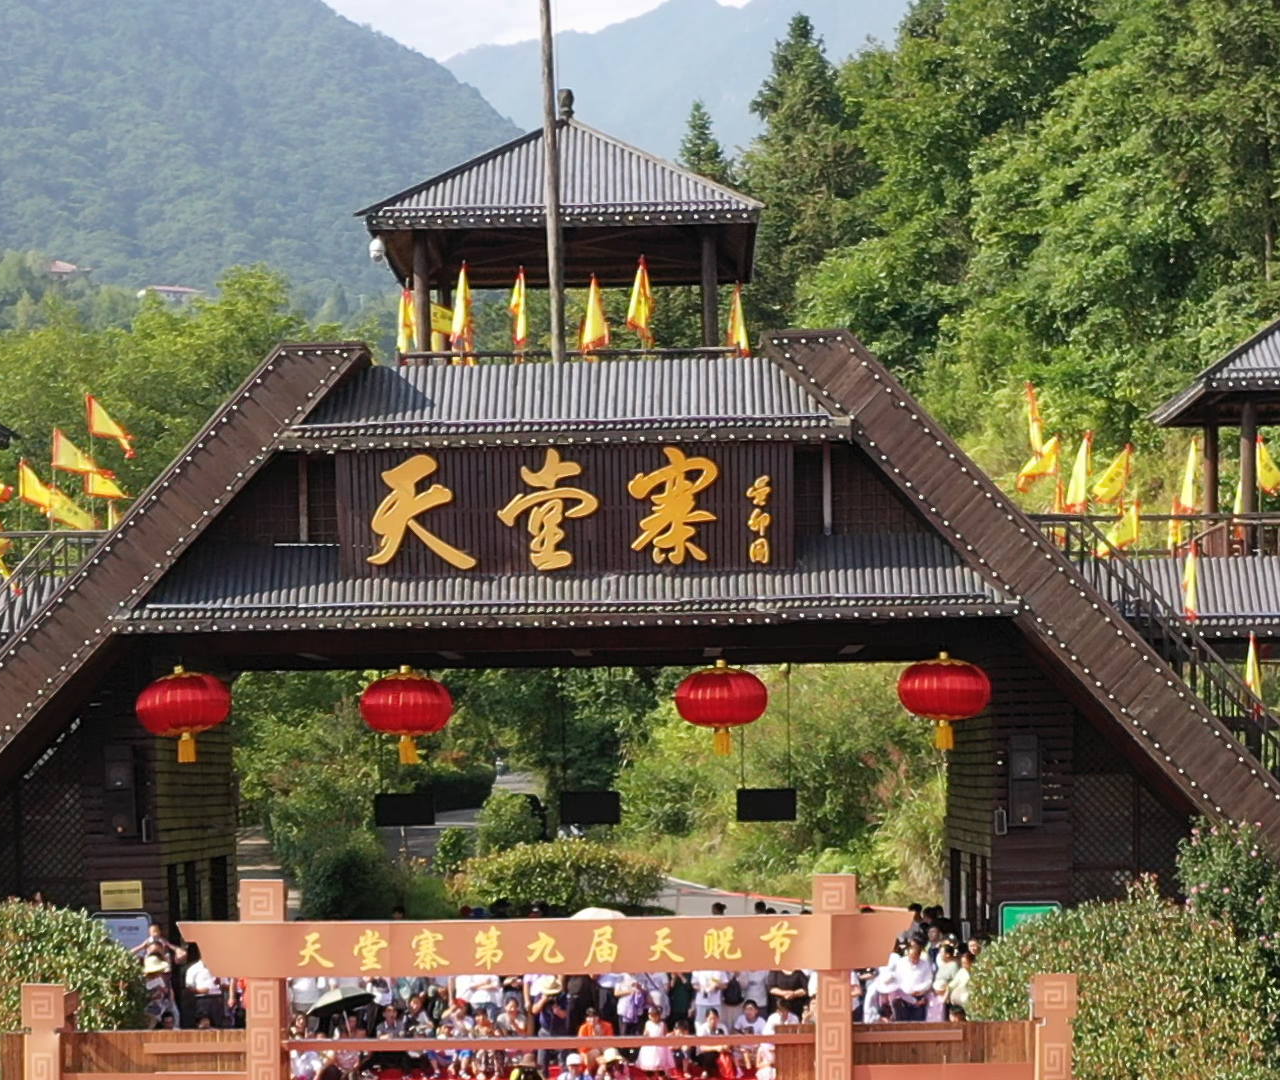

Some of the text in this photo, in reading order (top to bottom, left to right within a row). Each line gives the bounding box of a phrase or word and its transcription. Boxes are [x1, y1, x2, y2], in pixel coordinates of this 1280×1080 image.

[366, 446, 719, 570] 天堂寨
[297, 921, 799, 971] 天堂寨第九届天贶节
